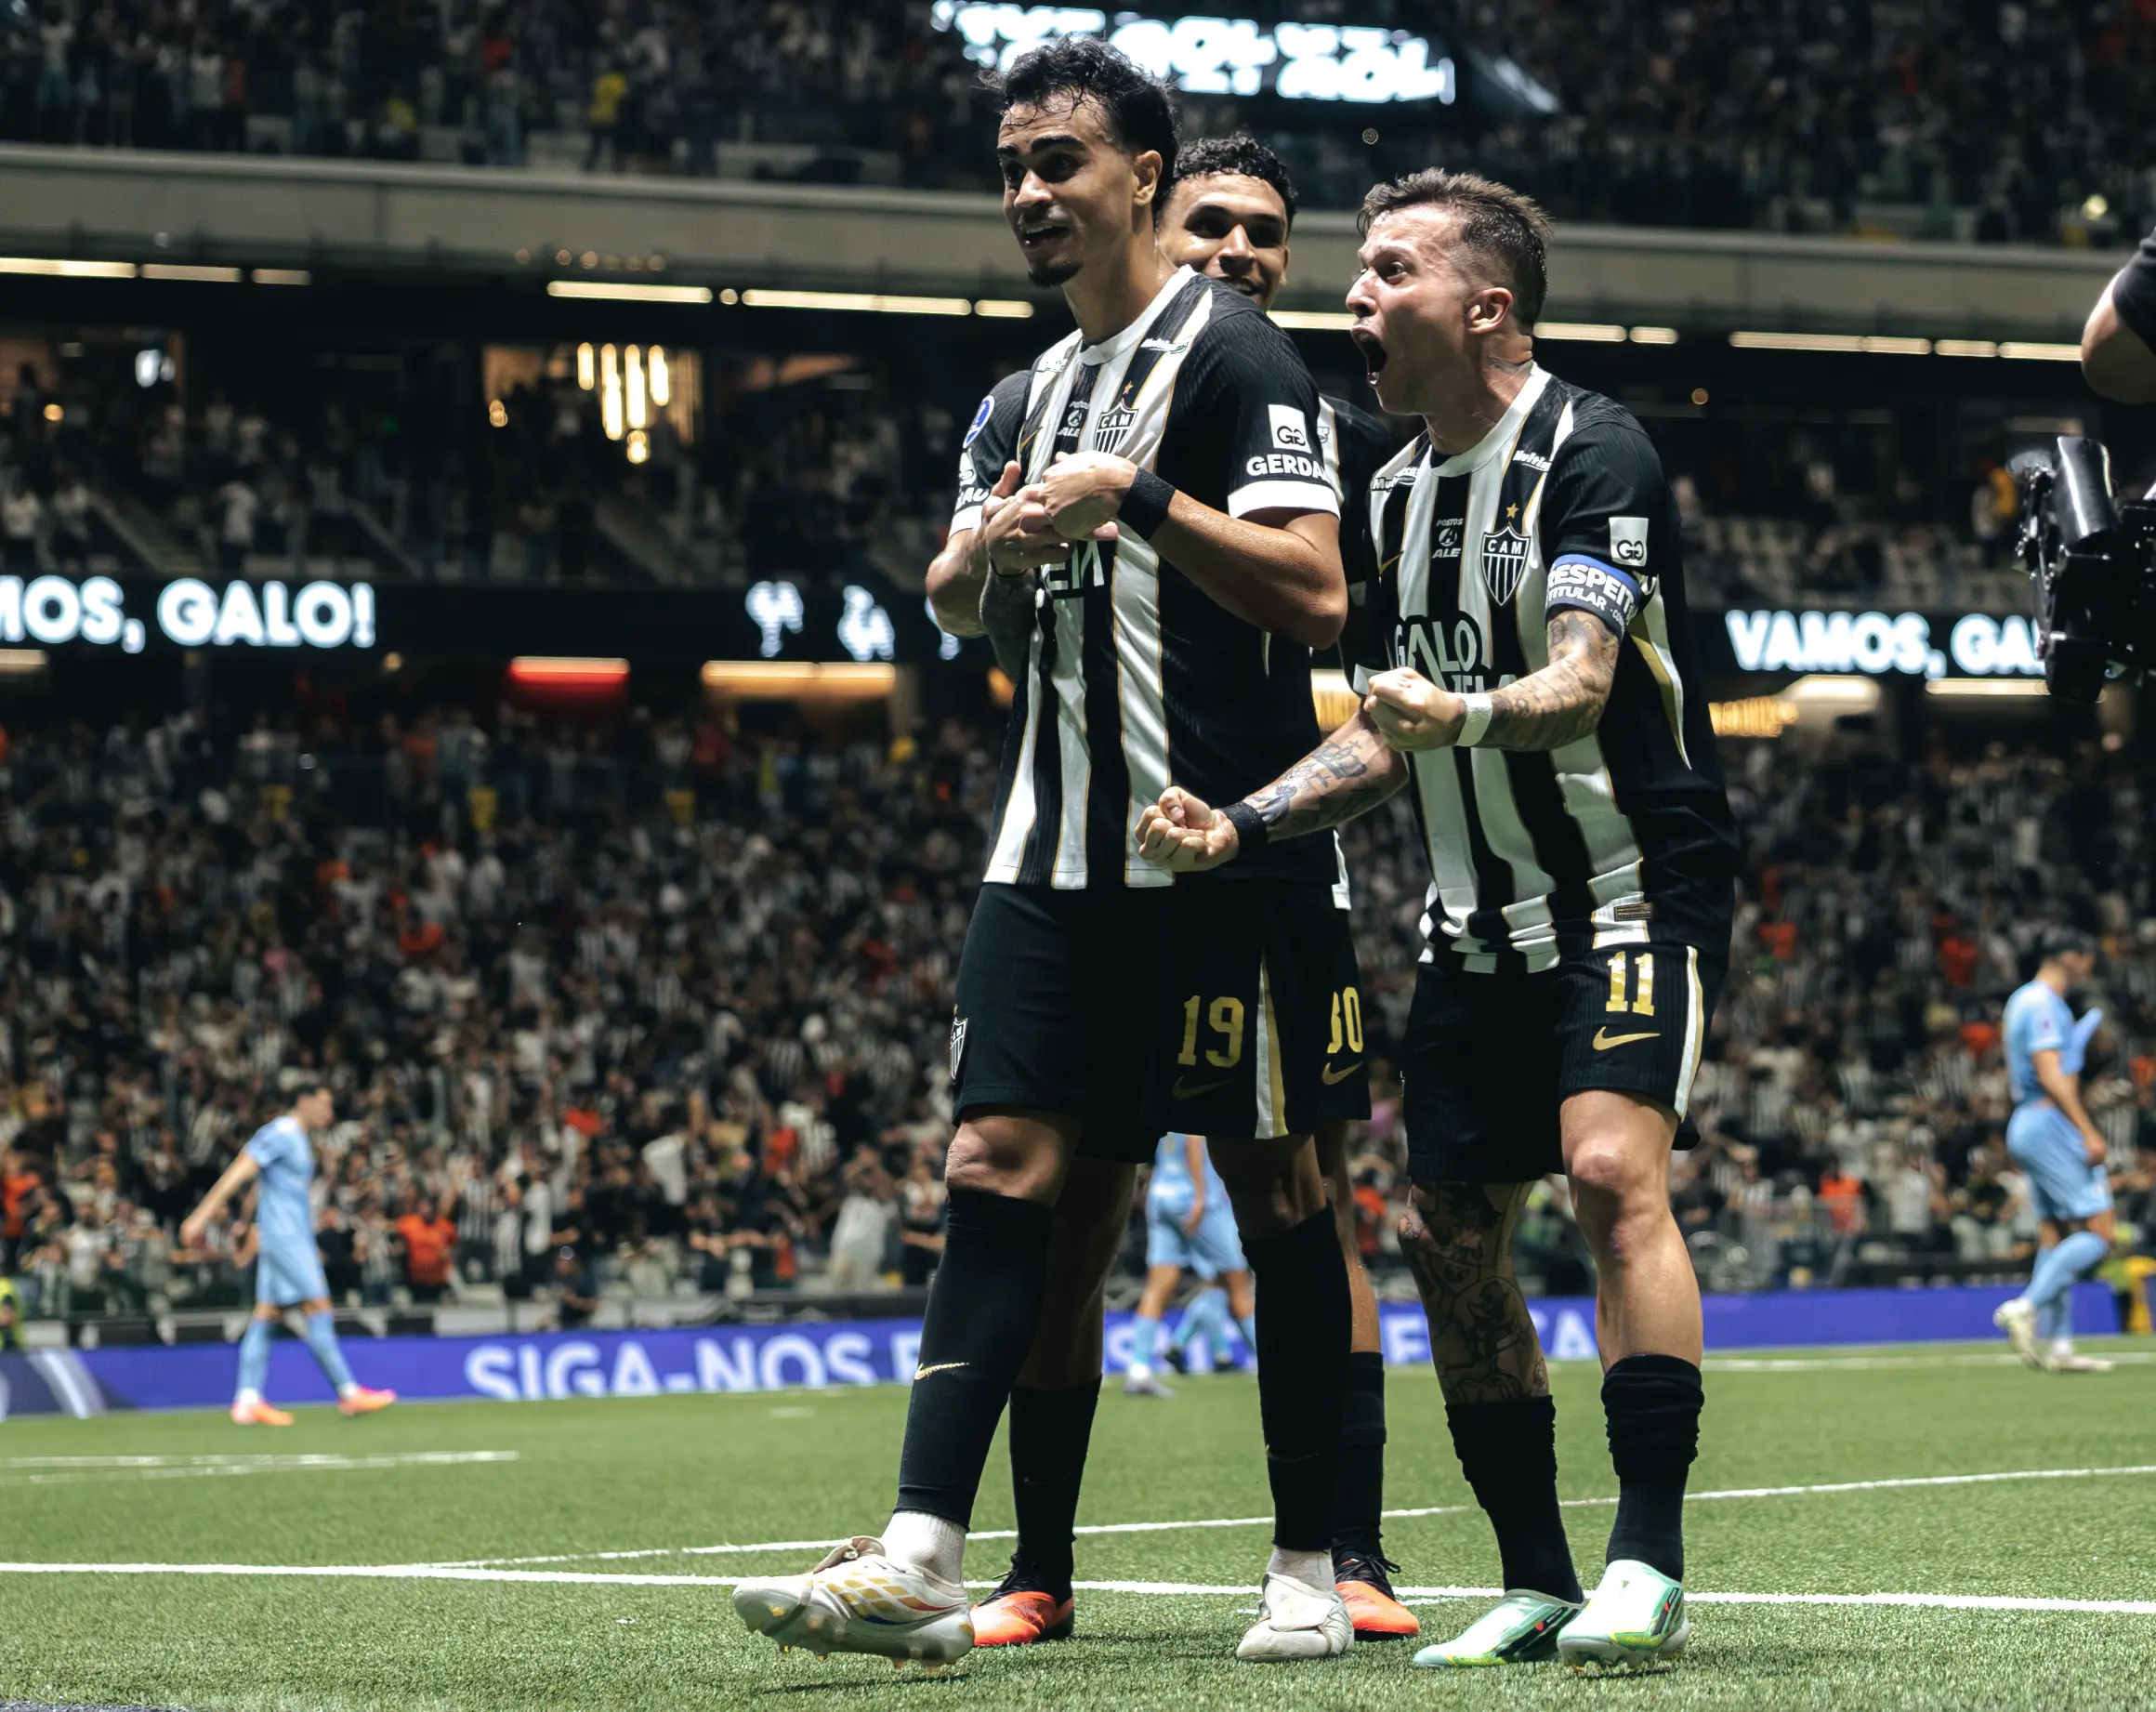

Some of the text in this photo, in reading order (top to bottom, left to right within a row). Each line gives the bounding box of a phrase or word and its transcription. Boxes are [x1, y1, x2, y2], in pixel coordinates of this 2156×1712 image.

[1100, 414, 1131, 427] CAM
[1246, 454, 1328, 480] GERDA
[1432, 547, 1462, 559] ALE
[1436, 518, 1464, 527] POSTOS
[1488, 539, 1523, 555] CAM
[157, 580, 375, 649] GALO!
[1725, 609, 1947, 680] VAMOS,
[1394, 619, 1478, 693] GALO
[1605, 951, 1655, 1016] 11
[1177, 994, 1244, 1068] 19
[465, 1332, 878, 1401] SIGA-NOS
